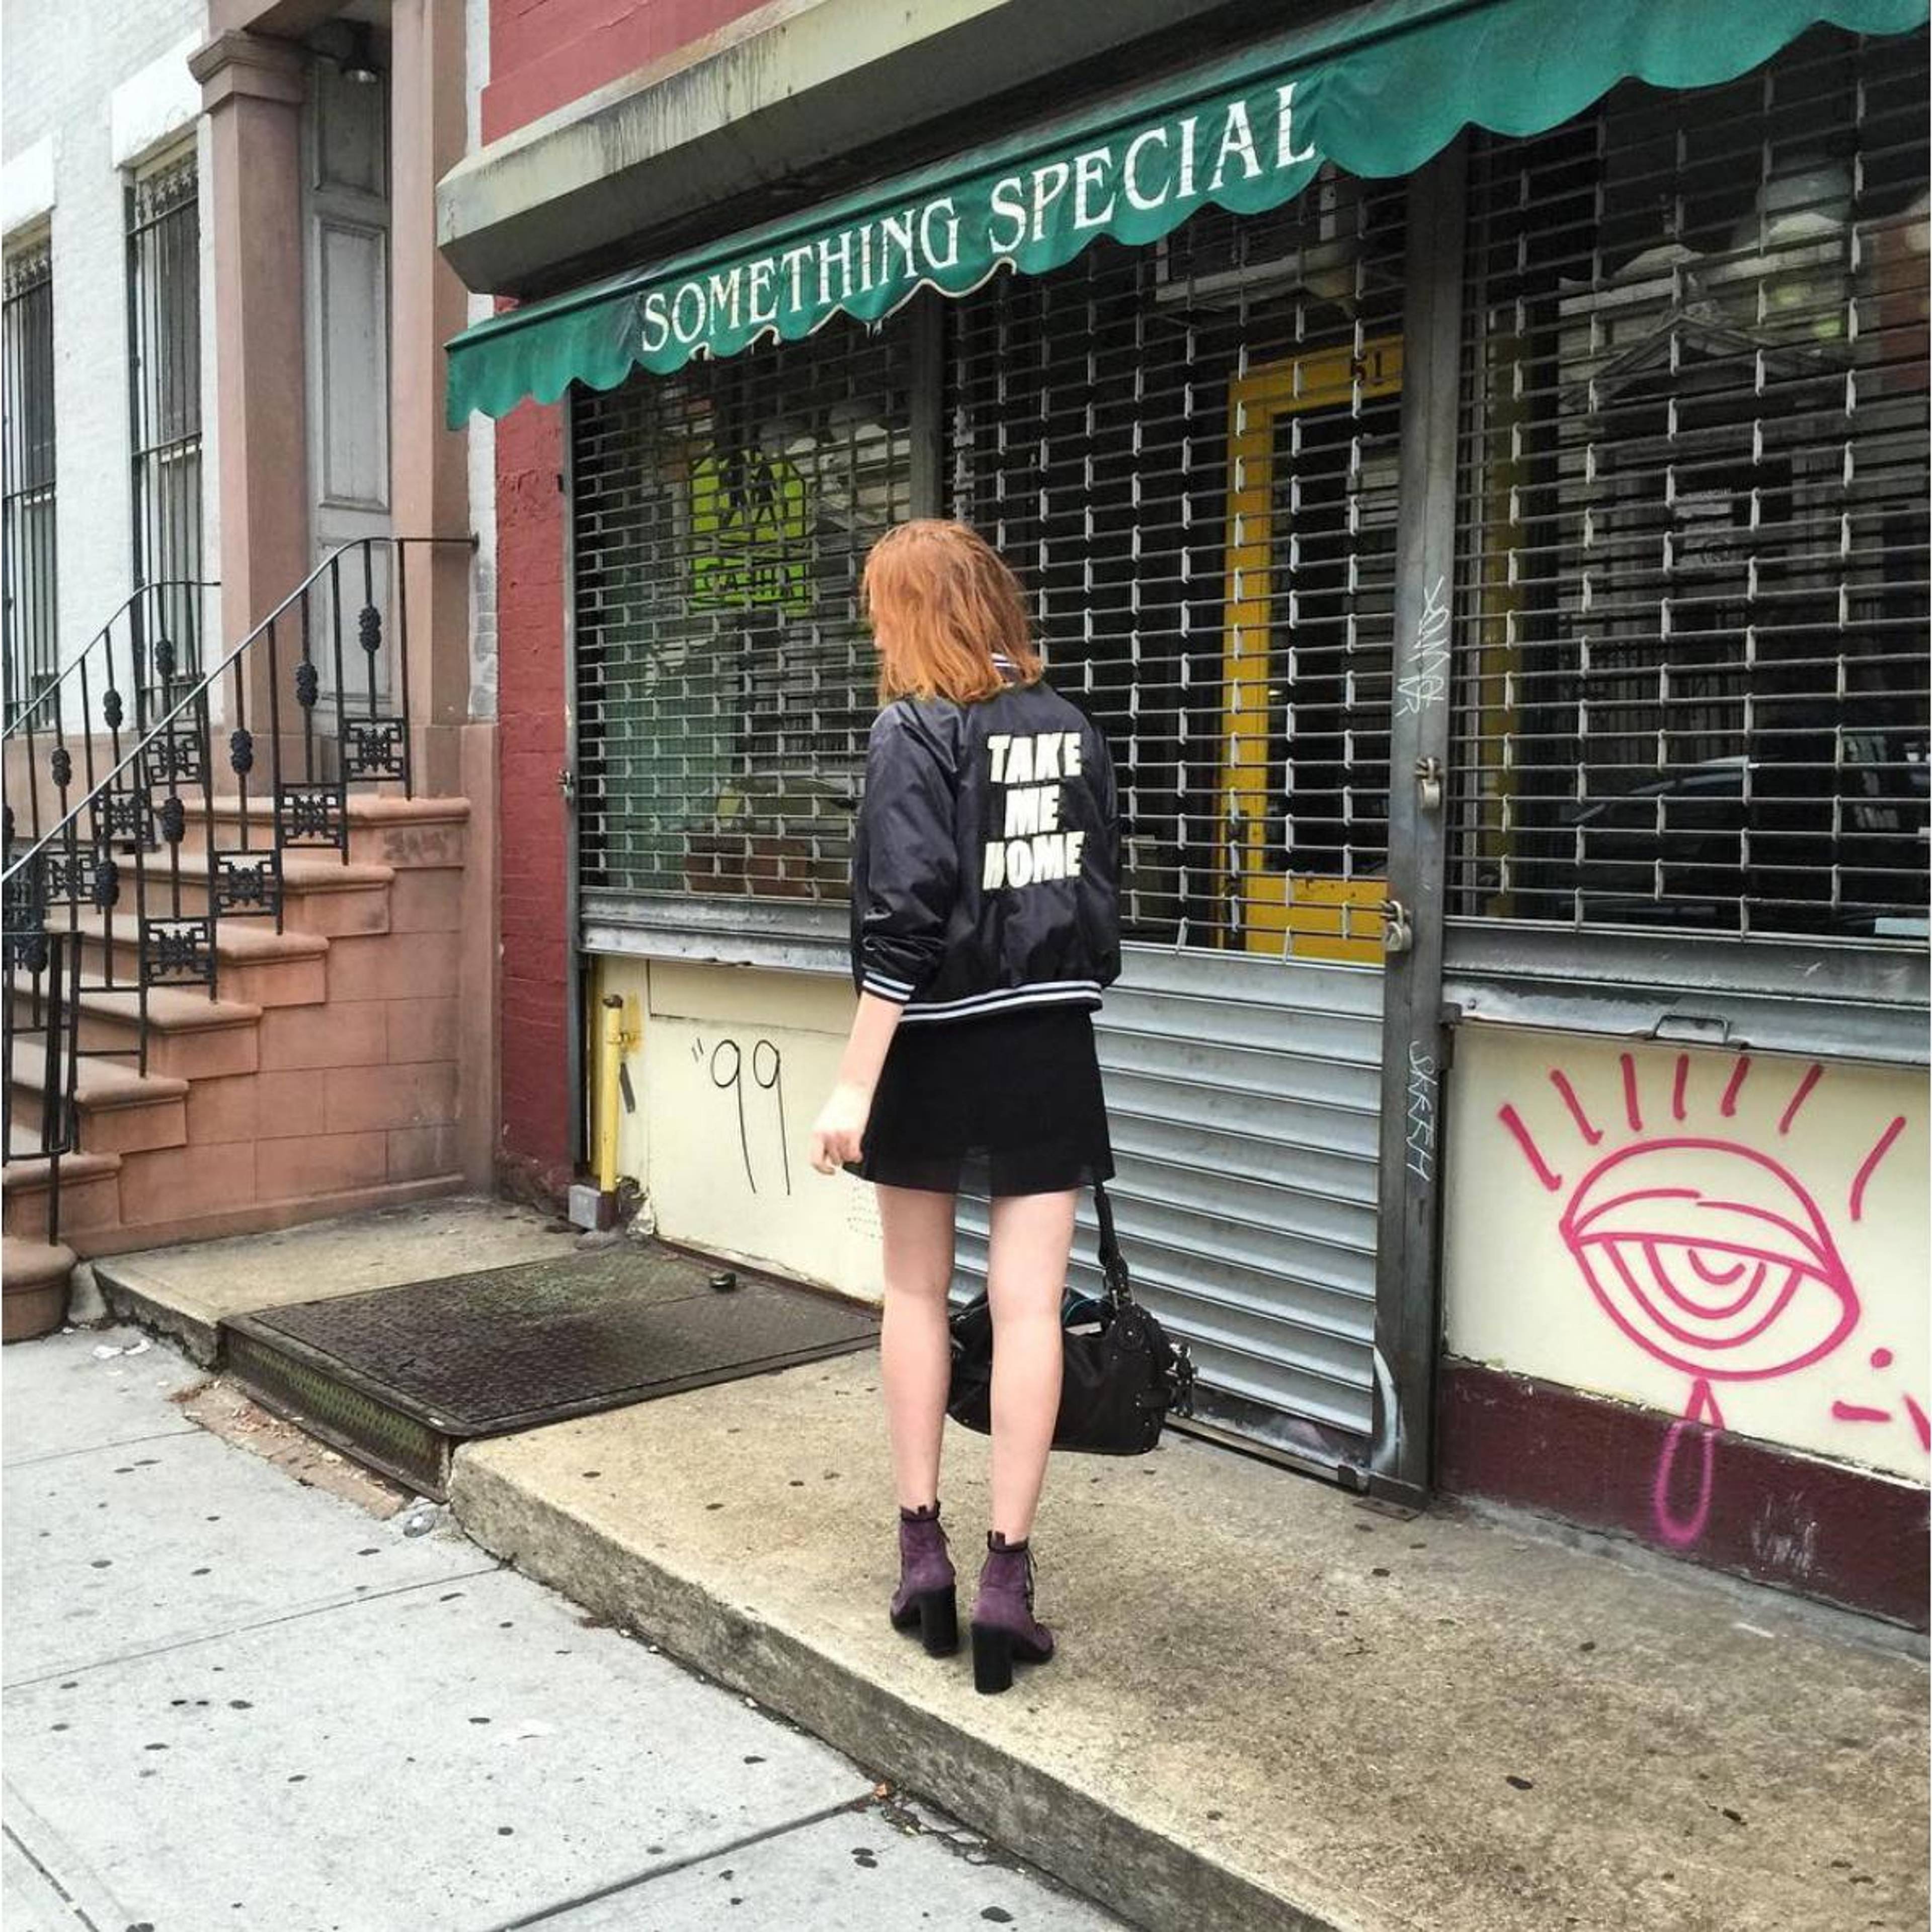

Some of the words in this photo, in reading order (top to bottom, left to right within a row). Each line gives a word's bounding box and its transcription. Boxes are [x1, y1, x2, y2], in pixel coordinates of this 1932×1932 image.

[641, 197, 960, 352] SOMETHING
[988, 82, 1316, 253] SPECIAL
[987, 732, 1082, 784] TAKE
[1004, 784, 1060, 838] ME
